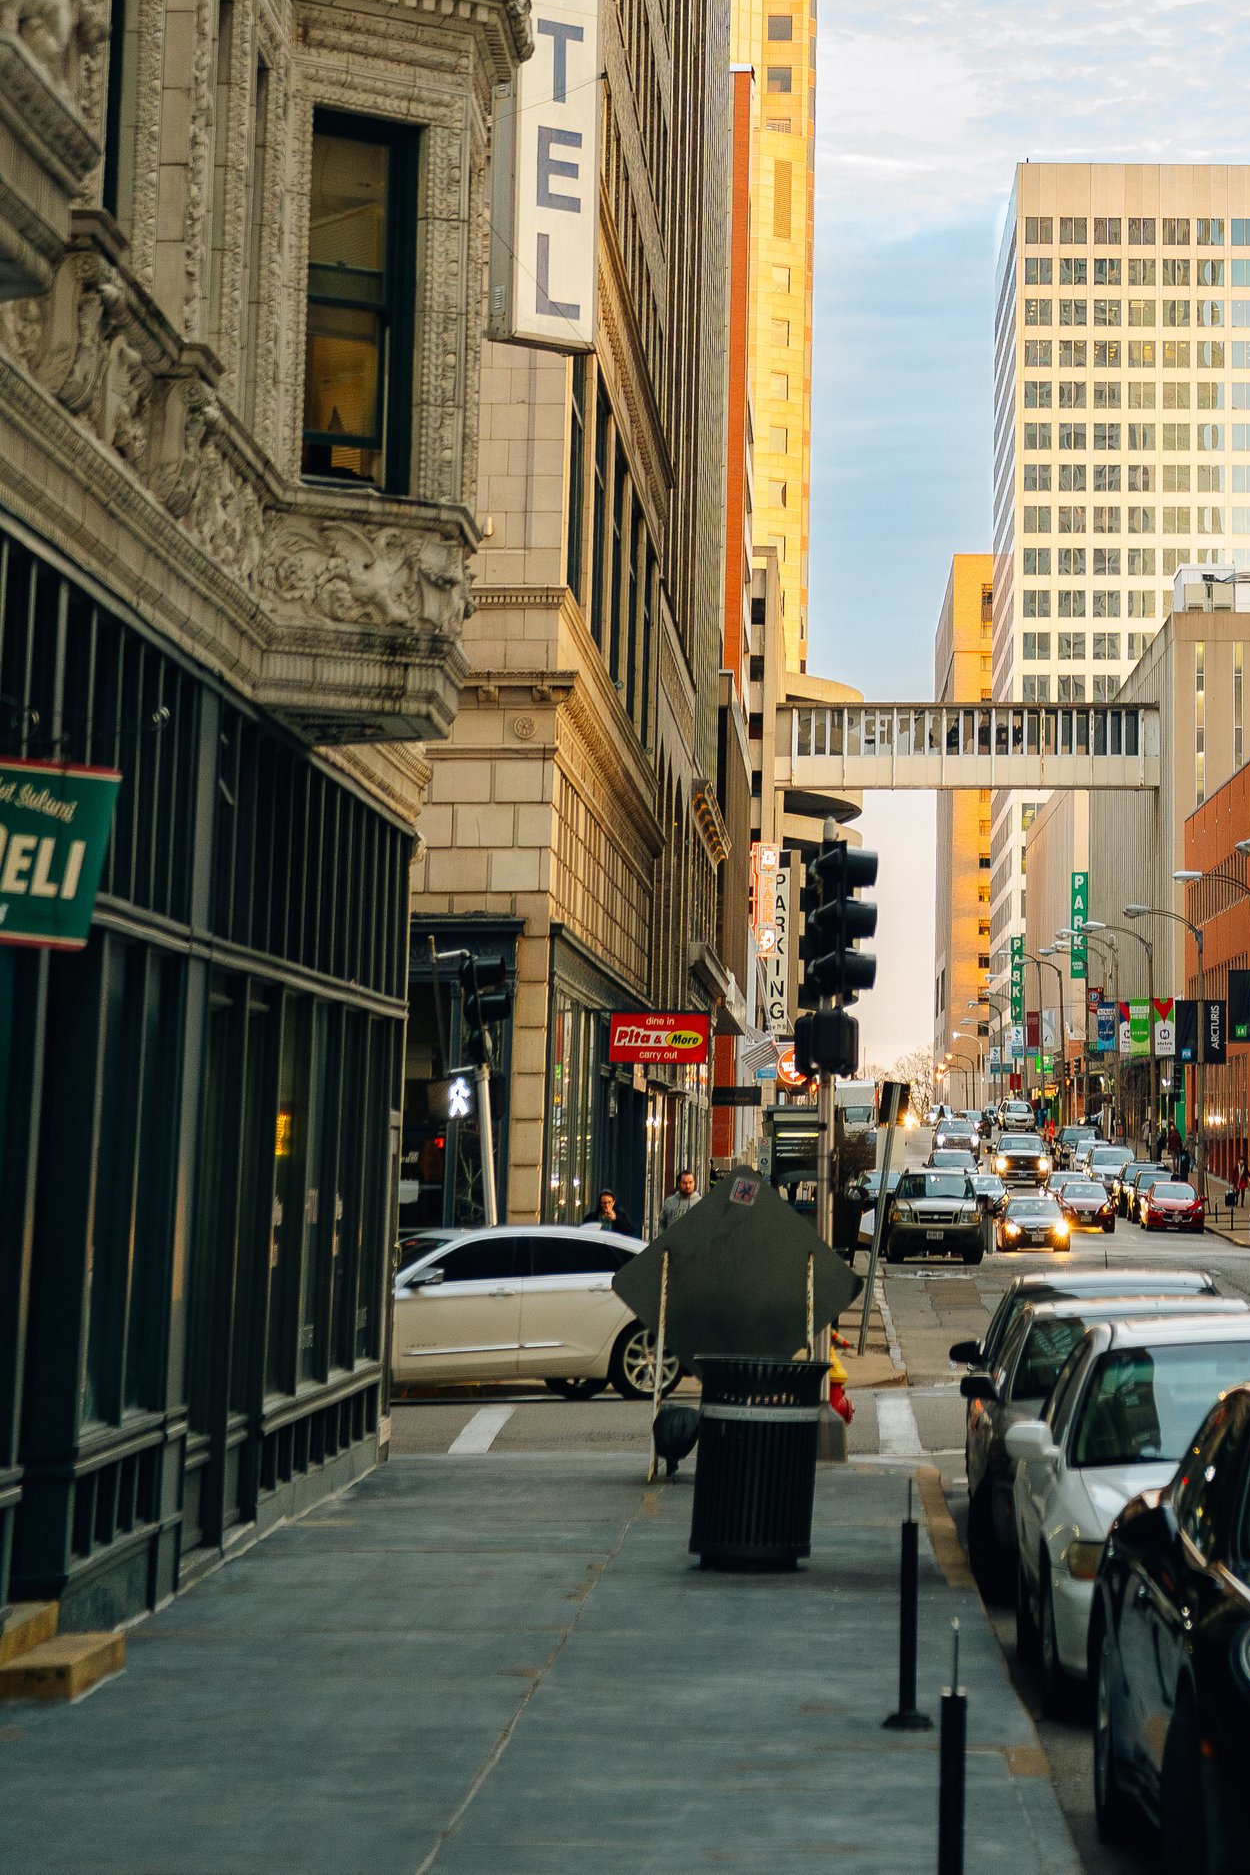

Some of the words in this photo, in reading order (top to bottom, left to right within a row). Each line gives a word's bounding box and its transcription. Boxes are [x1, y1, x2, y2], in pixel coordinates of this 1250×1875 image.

[0, 823, 86, 901] ELI
[763, 877, 774, 923] PARK
[1074, 875, 1084, 950] PARK
[769, 873, 786, 1020] PARKING
[1012, 939, 1021, 997] PARK
[617, 1028, 651, 1044] Pita
[654, 1036, 662, 1044] &
[671, 1035, 699, 1044] More
[646, 1017, 664, 1025] dine
[667, 1017, 674, 1025] in
[1211, 1005, 1219, 1049] ARCTURIS
[639, 1051, 661, 1061] carry
[663, 1050, 678, 1059] out
